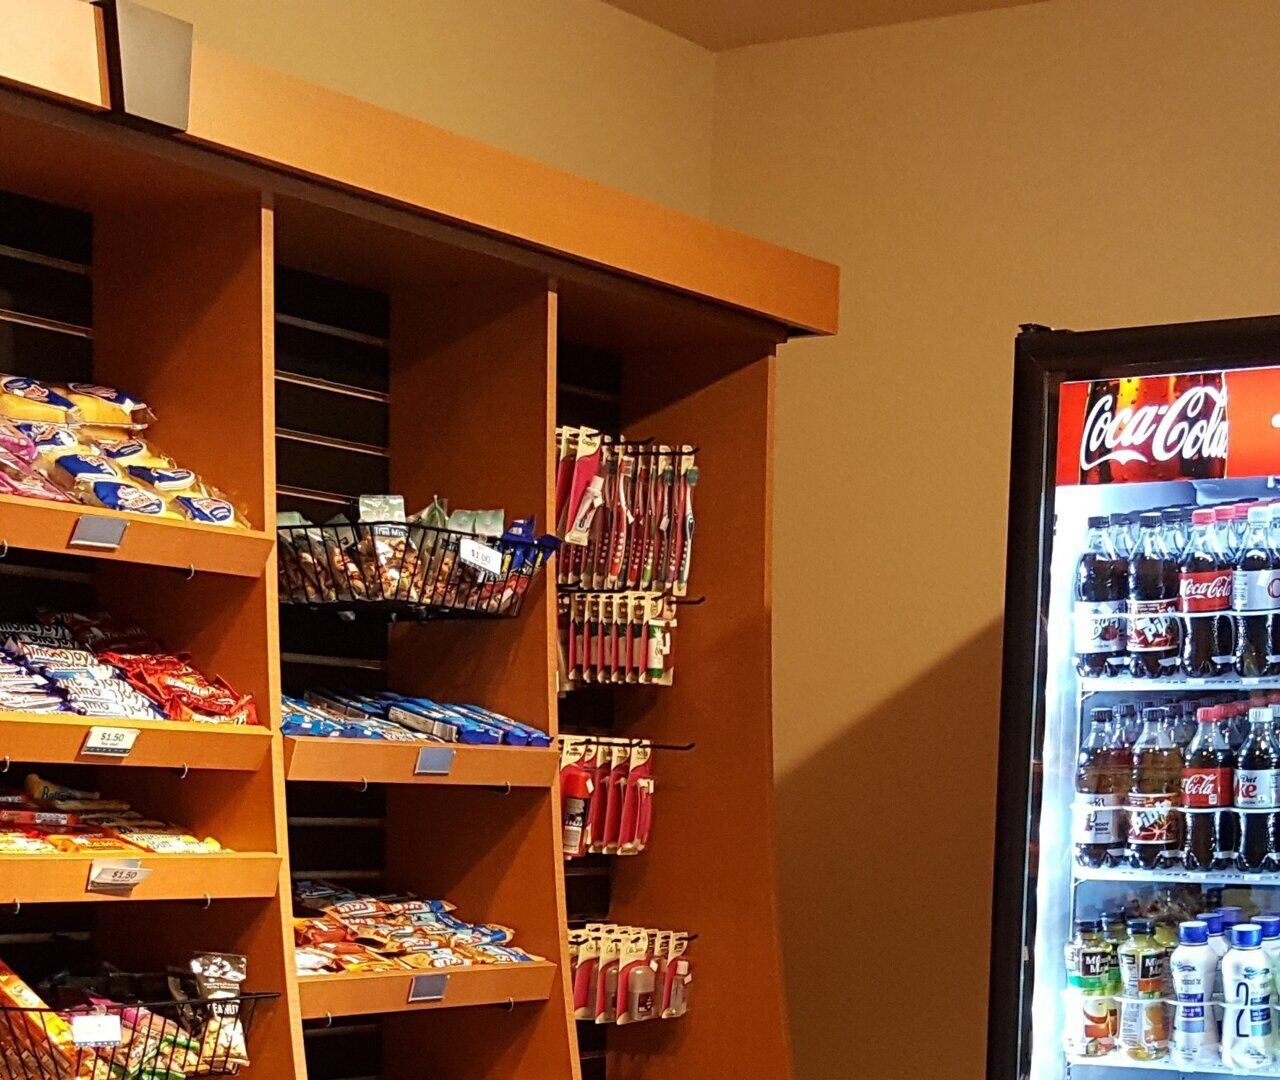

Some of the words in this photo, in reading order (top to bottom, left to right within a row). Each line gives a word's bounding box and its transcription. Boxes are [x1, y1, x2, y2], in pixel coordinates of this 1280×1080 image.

[1080, 386, 1229, 471] Coca-Cola
[1182, 572, 1232, 599] Coca-Cola
[101, 731, 125, 742] $1.50
[111, 869, 138, 879] $1.50
